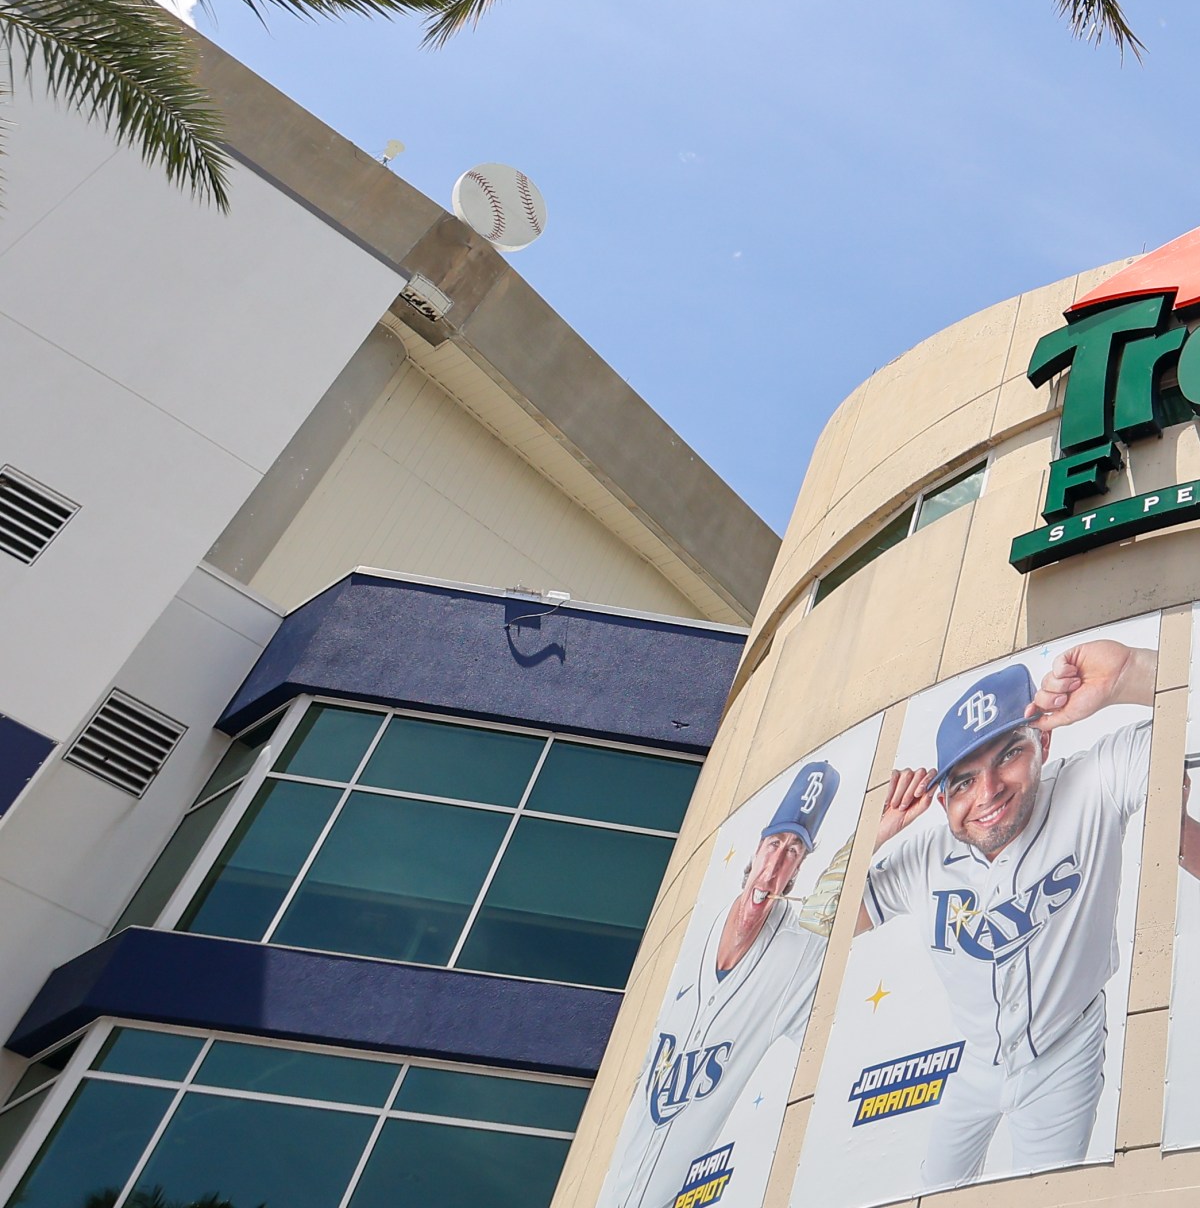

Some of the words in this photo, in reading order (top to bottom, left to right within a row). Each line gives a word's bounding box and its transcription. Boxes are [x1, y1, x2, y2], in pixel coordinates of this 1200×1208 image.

[1047, 512, 1117, 543] ST.
[957, 689, 1000, 733] TB
[931, 854, 1083, 968] RAYS
[647, 1032, 733, 1128] RAYS
[853, 1046, 961, 1096] JONATHAN
[858, 1078, 944, 1121] ARANDA
[686, 1147, 730, 1186] RYAN
[675, 1173, 730, 1208] PEPIOT
